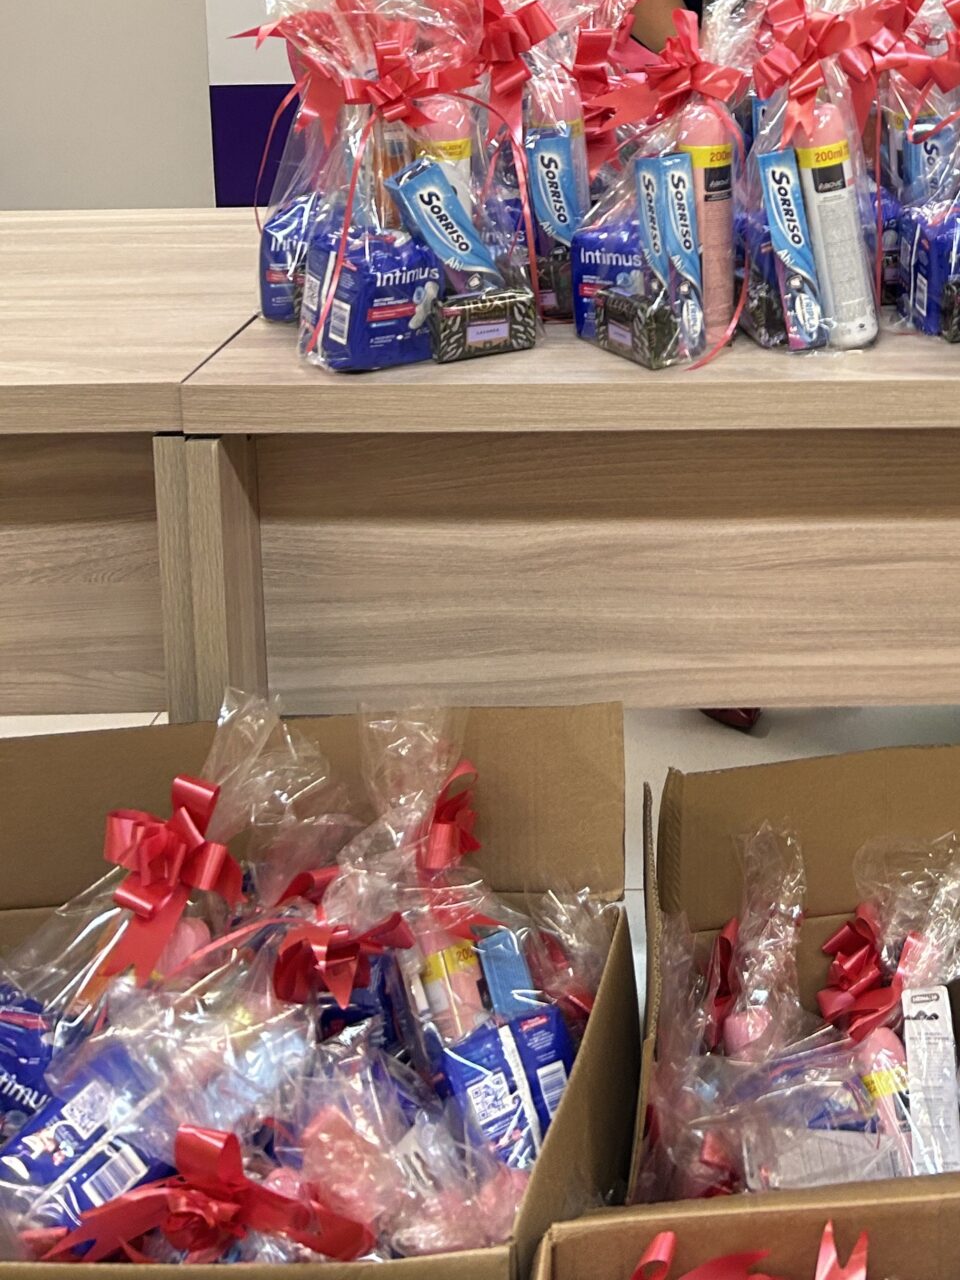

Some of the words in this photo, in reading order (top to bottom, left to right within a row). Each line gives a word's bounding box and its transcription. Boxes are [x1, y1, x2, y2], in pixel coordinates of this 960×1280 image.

[815, 148, 843, 163] 200ml
[541, 154, 568, 224] SORRISO
[772, 169, 803, 246] SORRISO
[419, 190, 470, 252] SORRISO
[671, 173, 693, 251] SORRISO
[375, 267, 440, 288] Intimus
[580, 247, 642, 267] Intimus
[778, 248, 795, 267] Ah!
